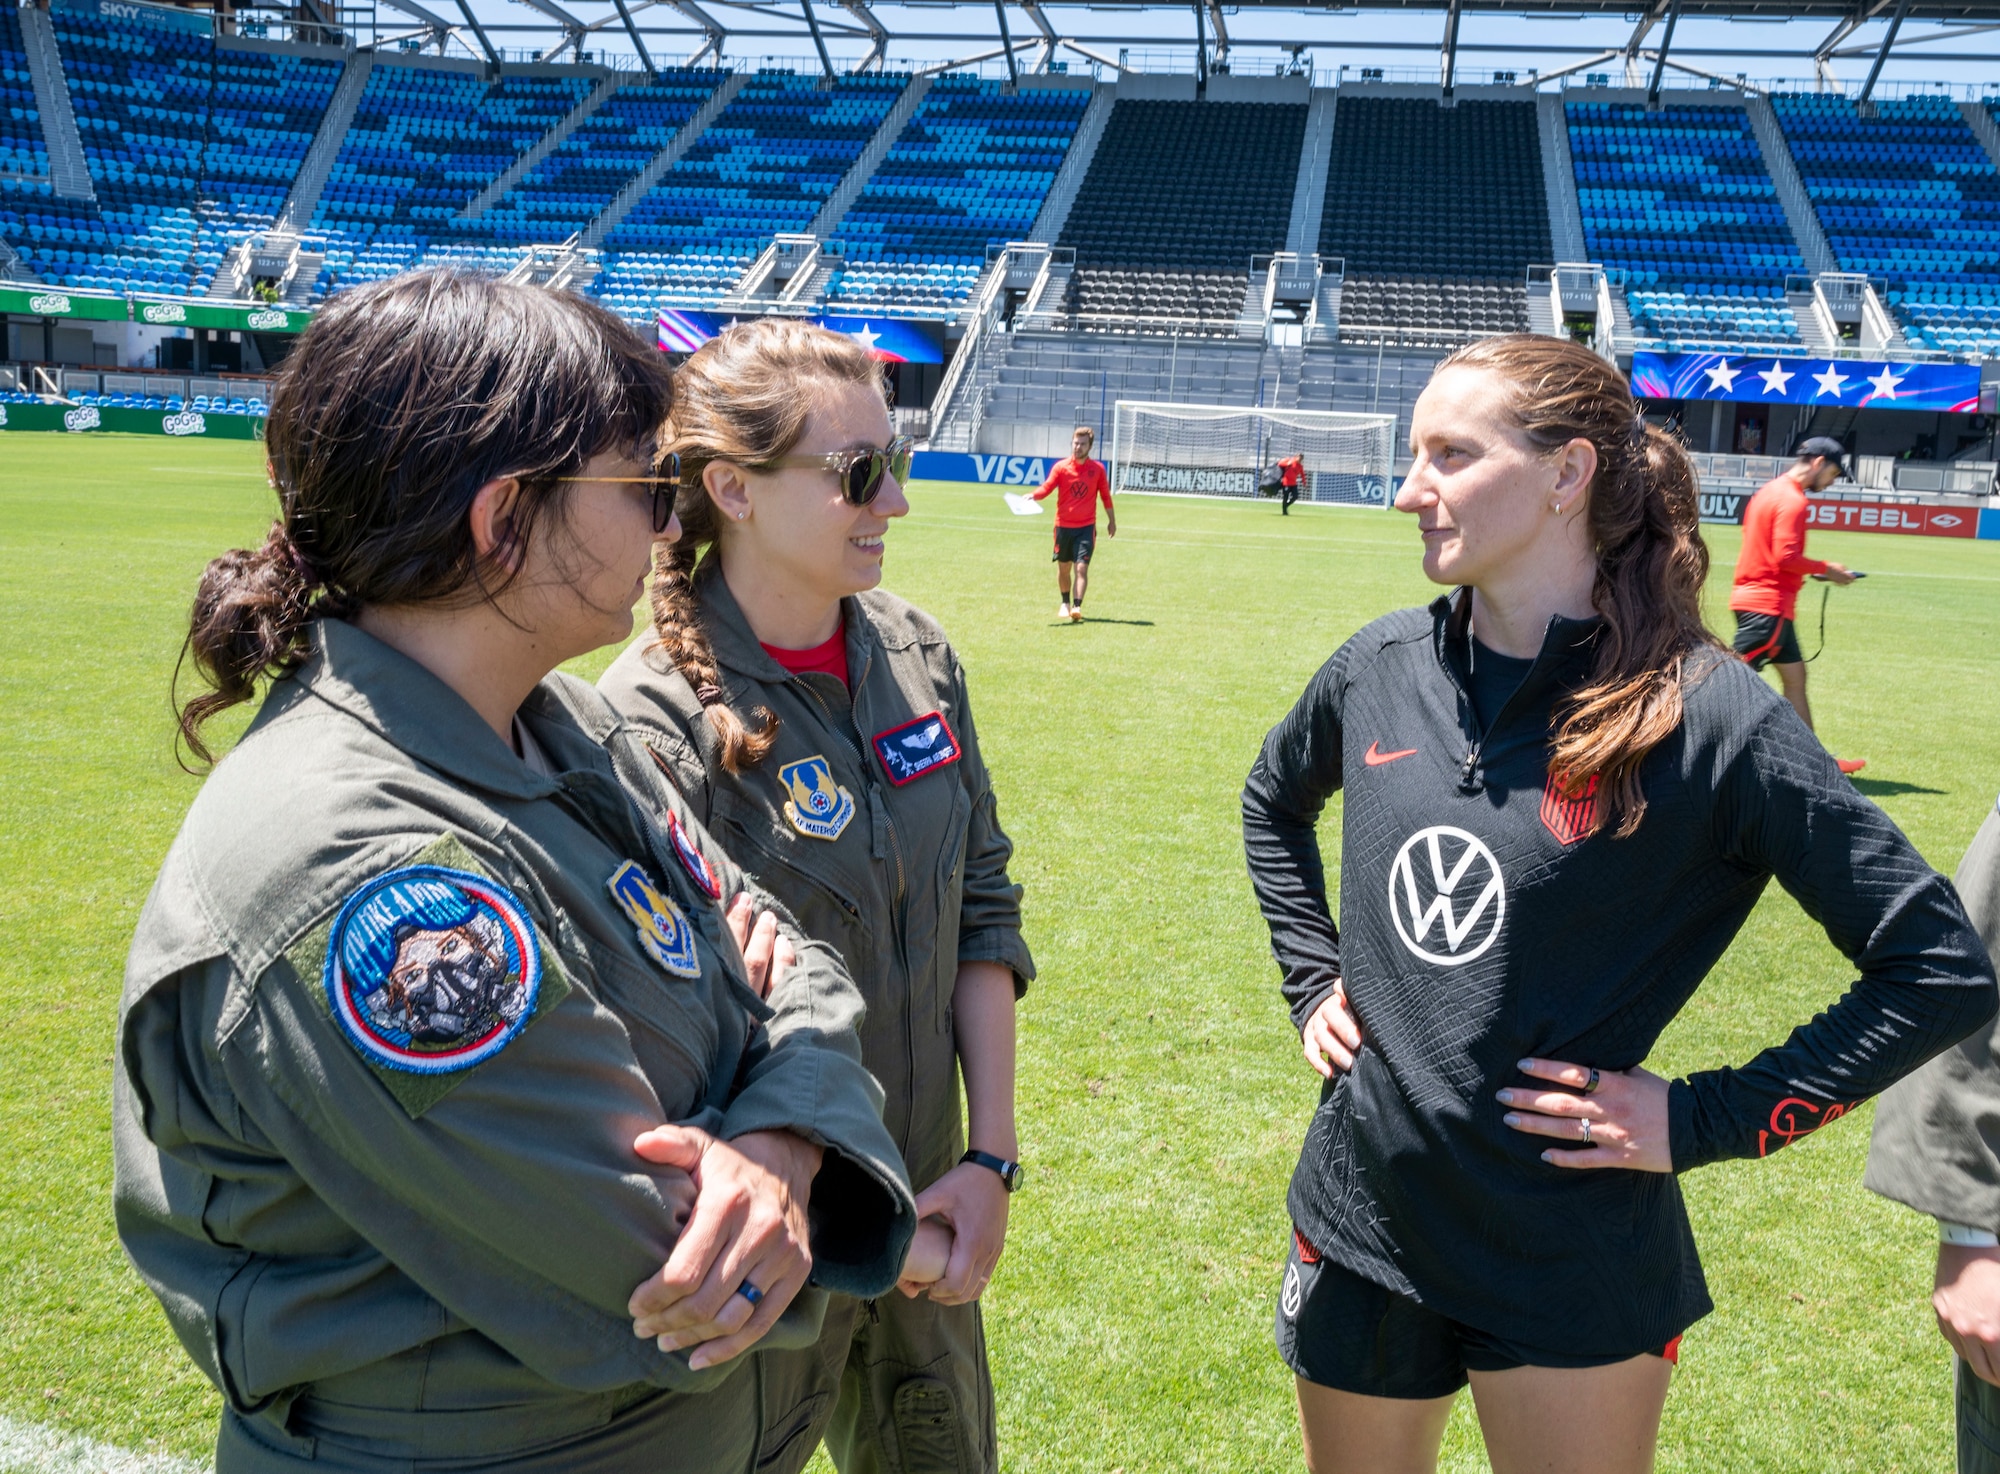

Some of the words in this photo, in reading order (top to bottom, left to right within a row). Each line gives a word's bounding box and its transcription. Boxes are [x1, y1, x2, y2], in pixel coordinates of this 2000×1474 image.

[100, 2, 139, 19] SKYY
[258, 259, 271, 267] 122
[781, 262, 792, 270] 120
[1299, 282, 1310, 290] 117
[31, 294, 64, 311] GoGo
[1561, 292, 1573, 300] 117
[1580, 293, 1593, 301] 116
[145, 304, 178, 320] GoGo
[249, 311, 280, 327] GoGo
[66, 407, 94, 428] GoGo
[164, 413, 197, 432] GoGo
[968, 454, 1046, 486] VISA
[1119, 466, 1255, 493] NIKE.COM/SOCCER
[1357, 480, 1398, 500] Vol
[1700, 494, 1740, 517] ULY
[1389, 826, 1505, 965] VW
[389, 886, 427, 925] A
[356, 892, 401, 961] LIKE
[345, 920, 388, 990] FLY
